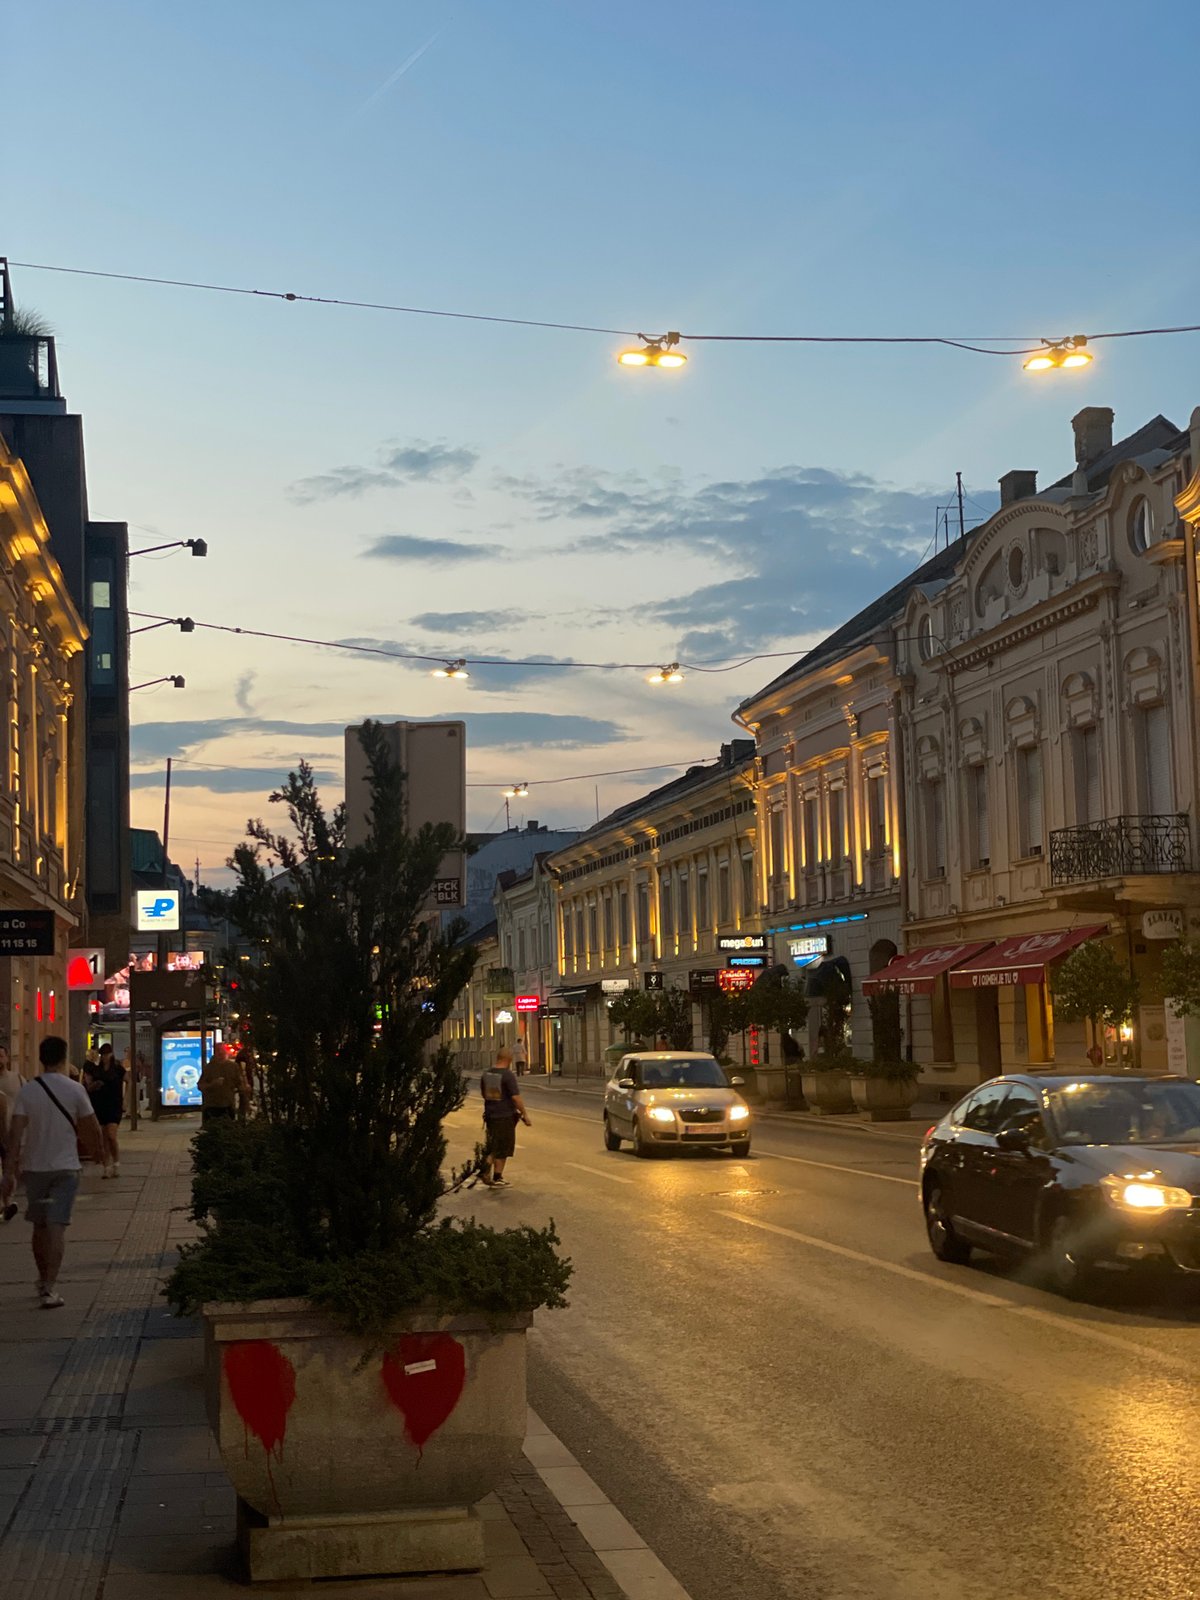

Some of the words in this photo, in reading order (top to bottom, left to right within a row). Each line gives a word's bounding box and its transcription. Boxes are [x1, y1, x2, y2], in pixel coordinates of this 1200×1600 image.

[437, 880, 458, 891] FCK
[437, 892, 458, 901] BLK
[12, 938, 25, 949] 15
[25, 938, 38, 949] 15
